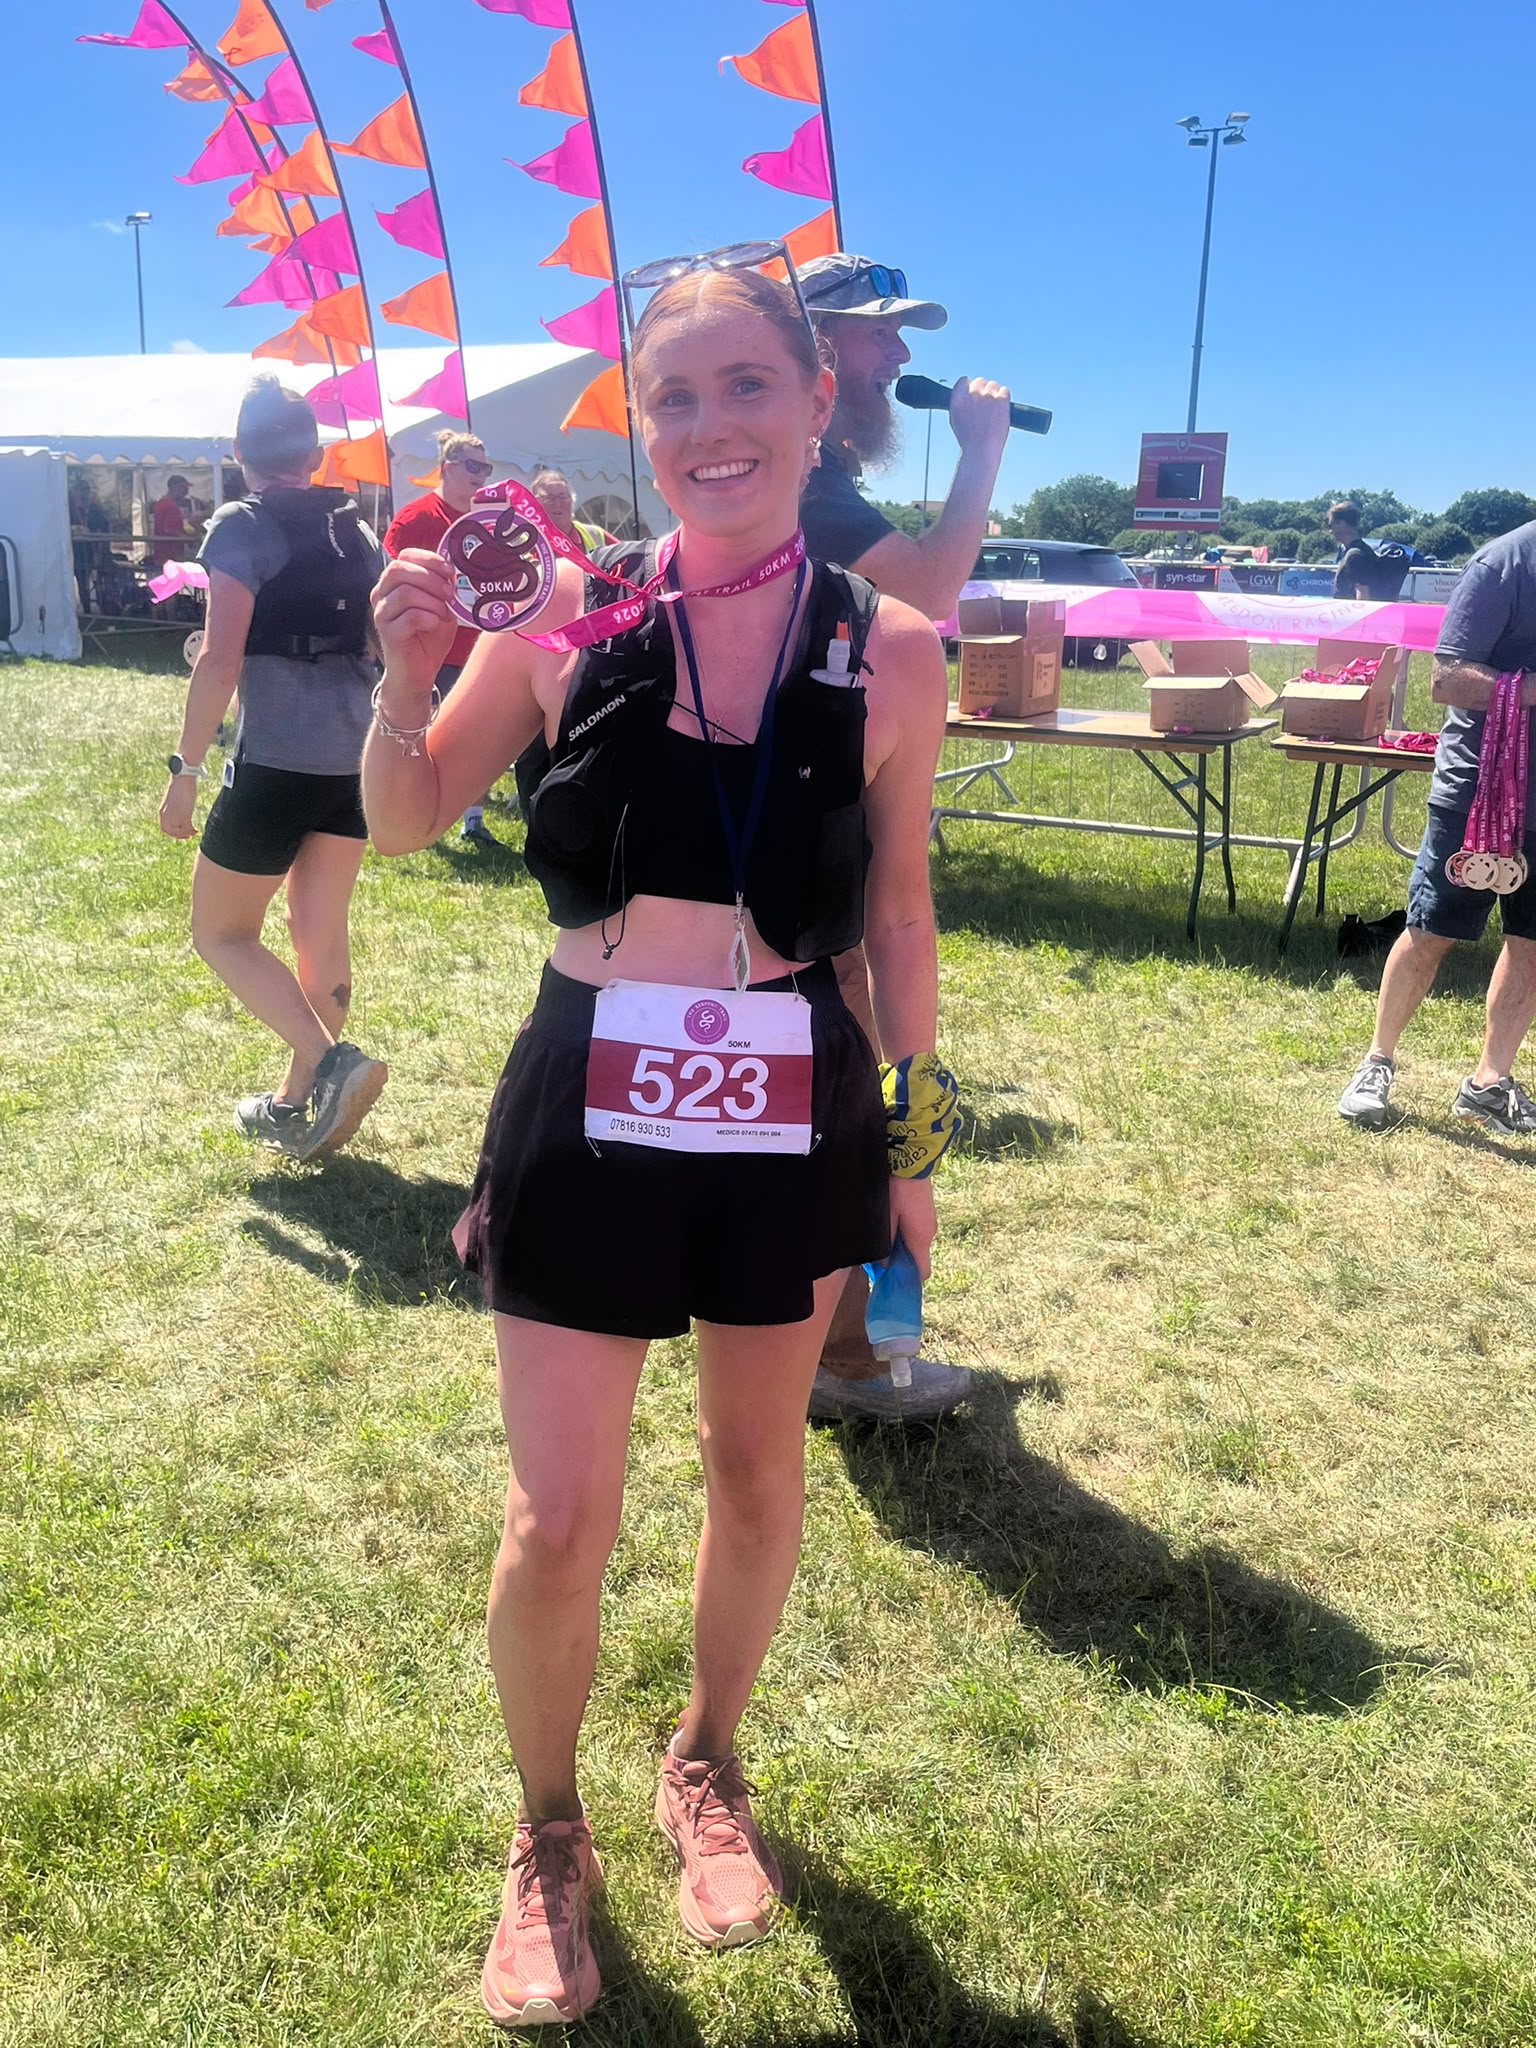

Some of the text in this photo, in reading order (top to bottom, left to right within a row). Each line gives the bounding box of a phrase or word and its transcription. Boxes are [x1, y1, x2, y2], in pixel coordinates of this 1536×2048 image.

[715, 580, 751, 595] TRAIL
[759, 552, 791, 581] 50KM
[1166, 572, 1207, 583] syn-star
[1250, 574, 1276, 585] LGW
[480, 582, 514, 593] 50KM
[613, 600, 645, 624] 2026
[1293, 602, 1366, 630] RACING
[568, 694, 627, 742] SALOMON
[728, 1040, 751, 1048] 50KM
[628, 1048, 770, 1121] 523
[610, 1118, 670, 1138] 07816 930 533
